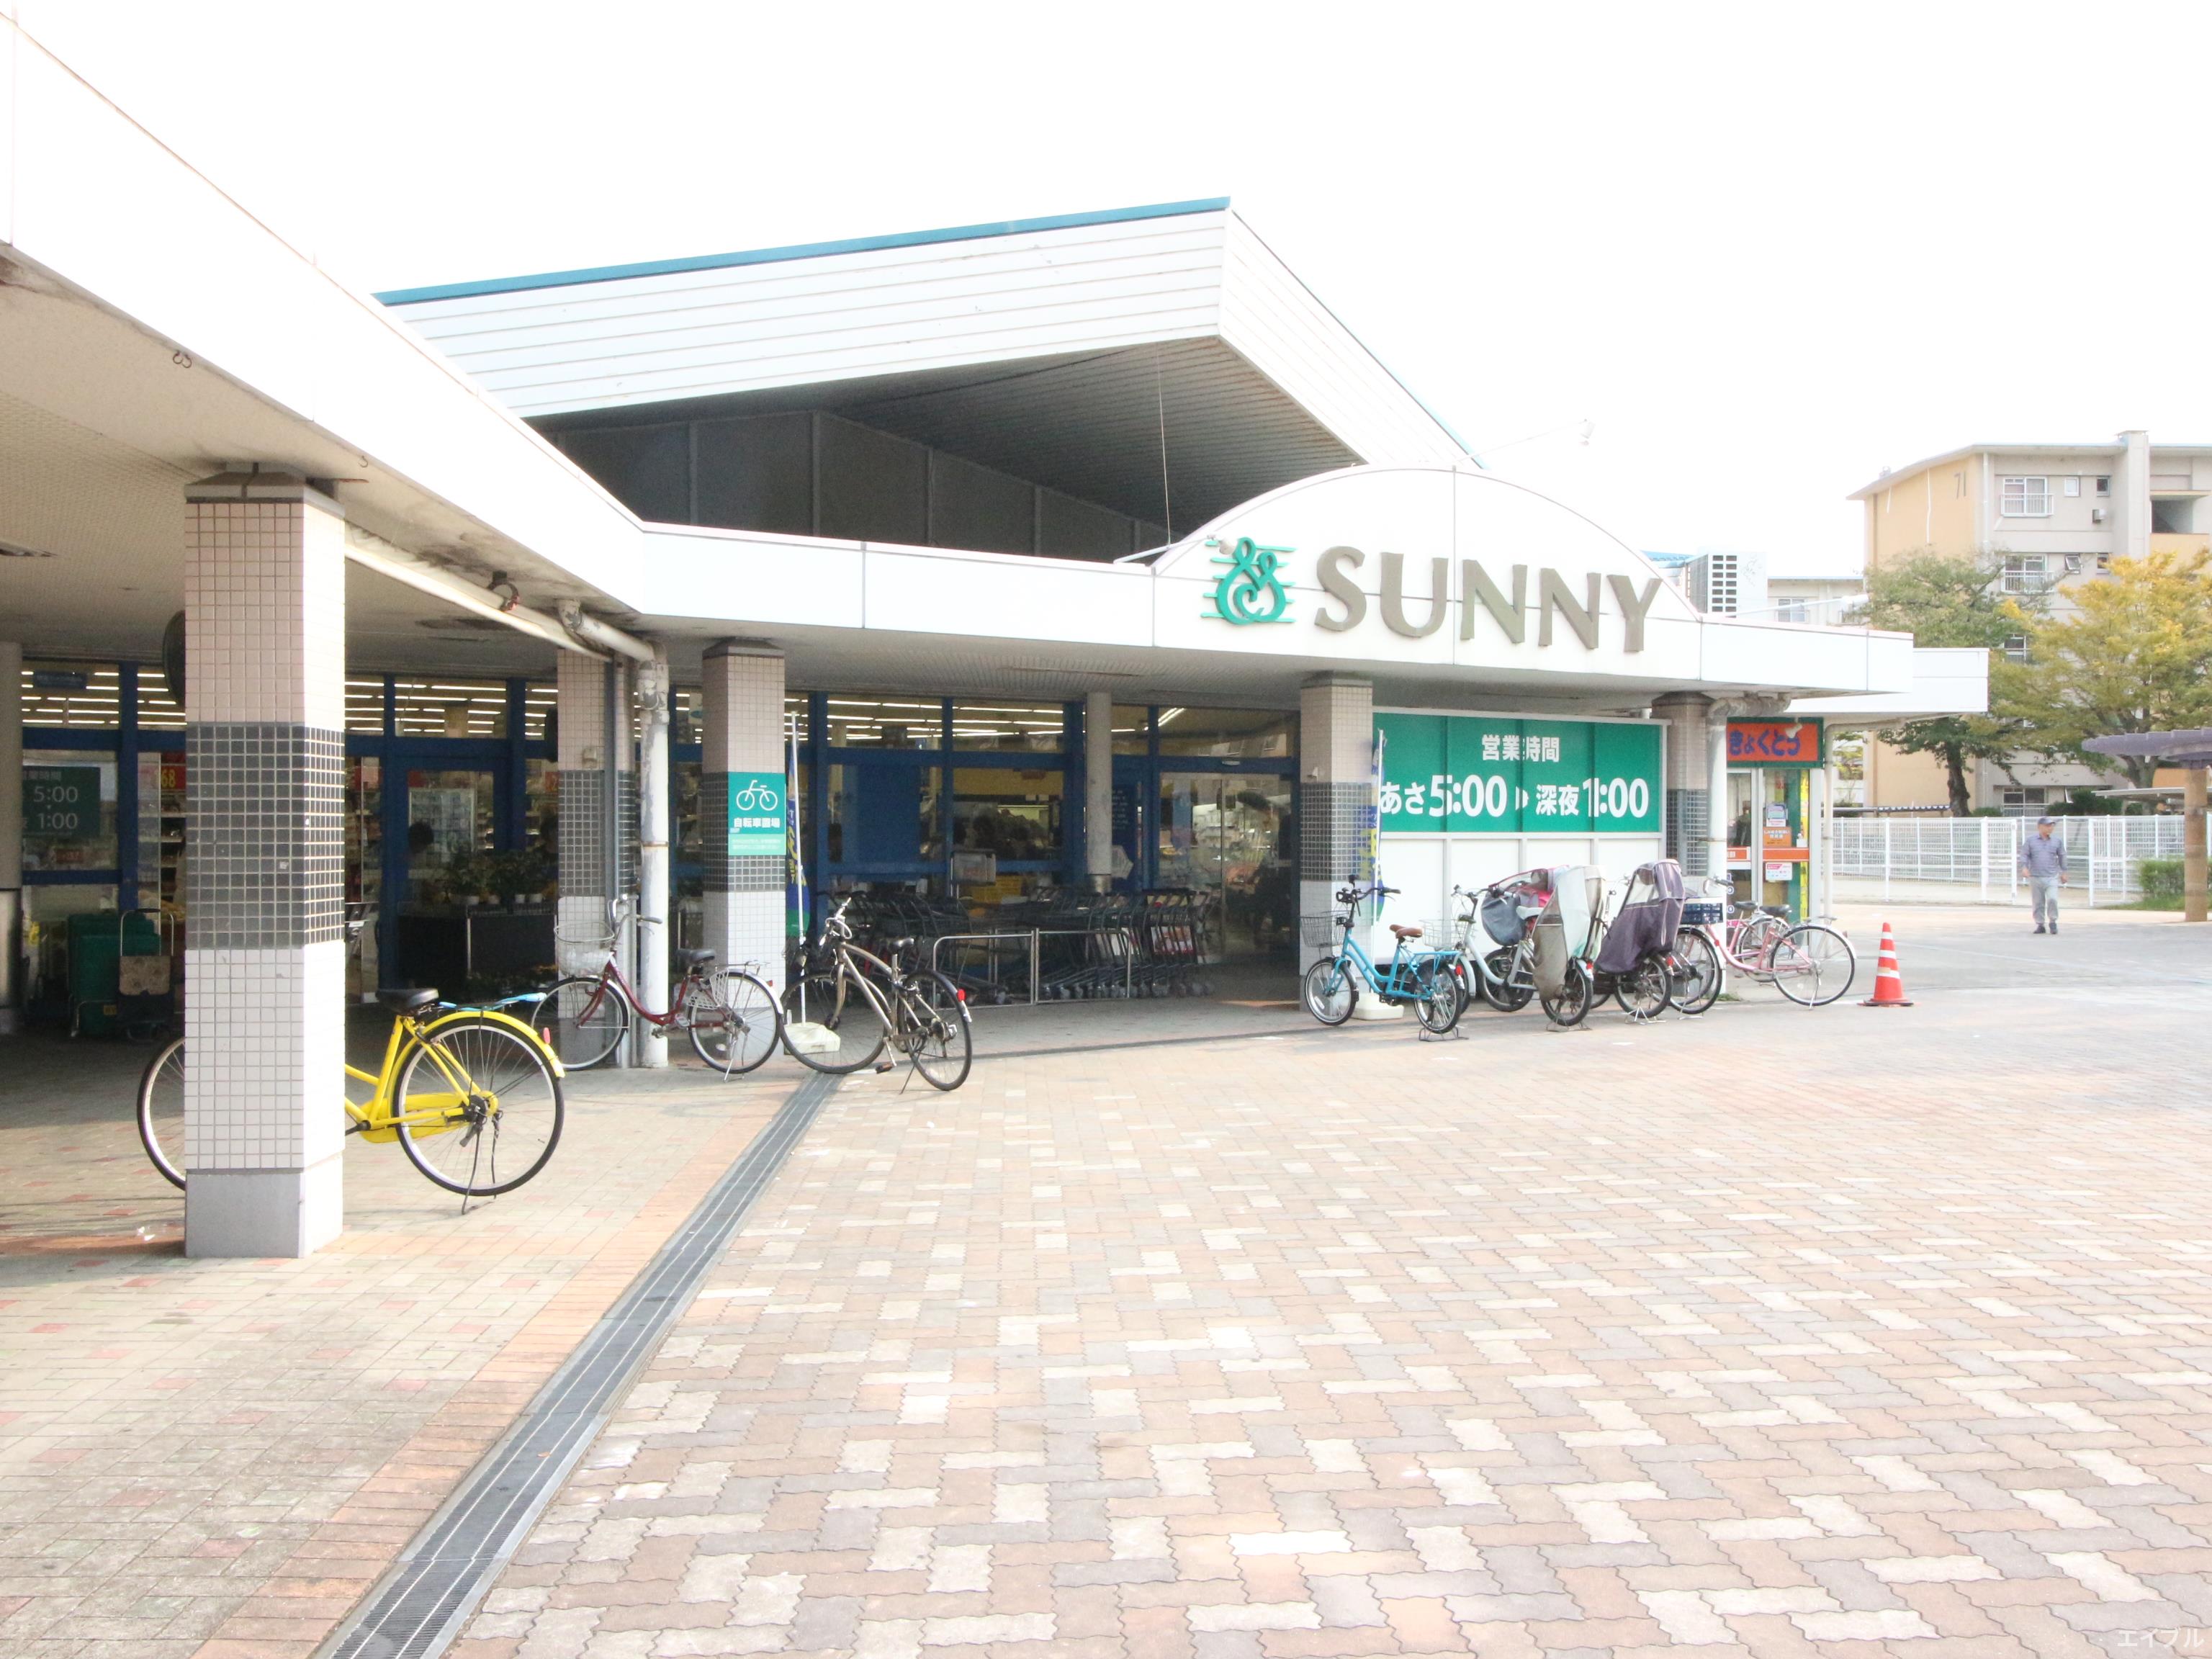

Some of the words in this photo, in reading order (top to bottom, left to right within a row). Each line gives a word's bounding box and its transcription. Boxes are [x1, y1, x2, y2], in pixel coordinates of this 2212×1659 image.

[1314, 546, 1663, 652] SUNNY
[1481, 734, 1560, 763] 営業時間
